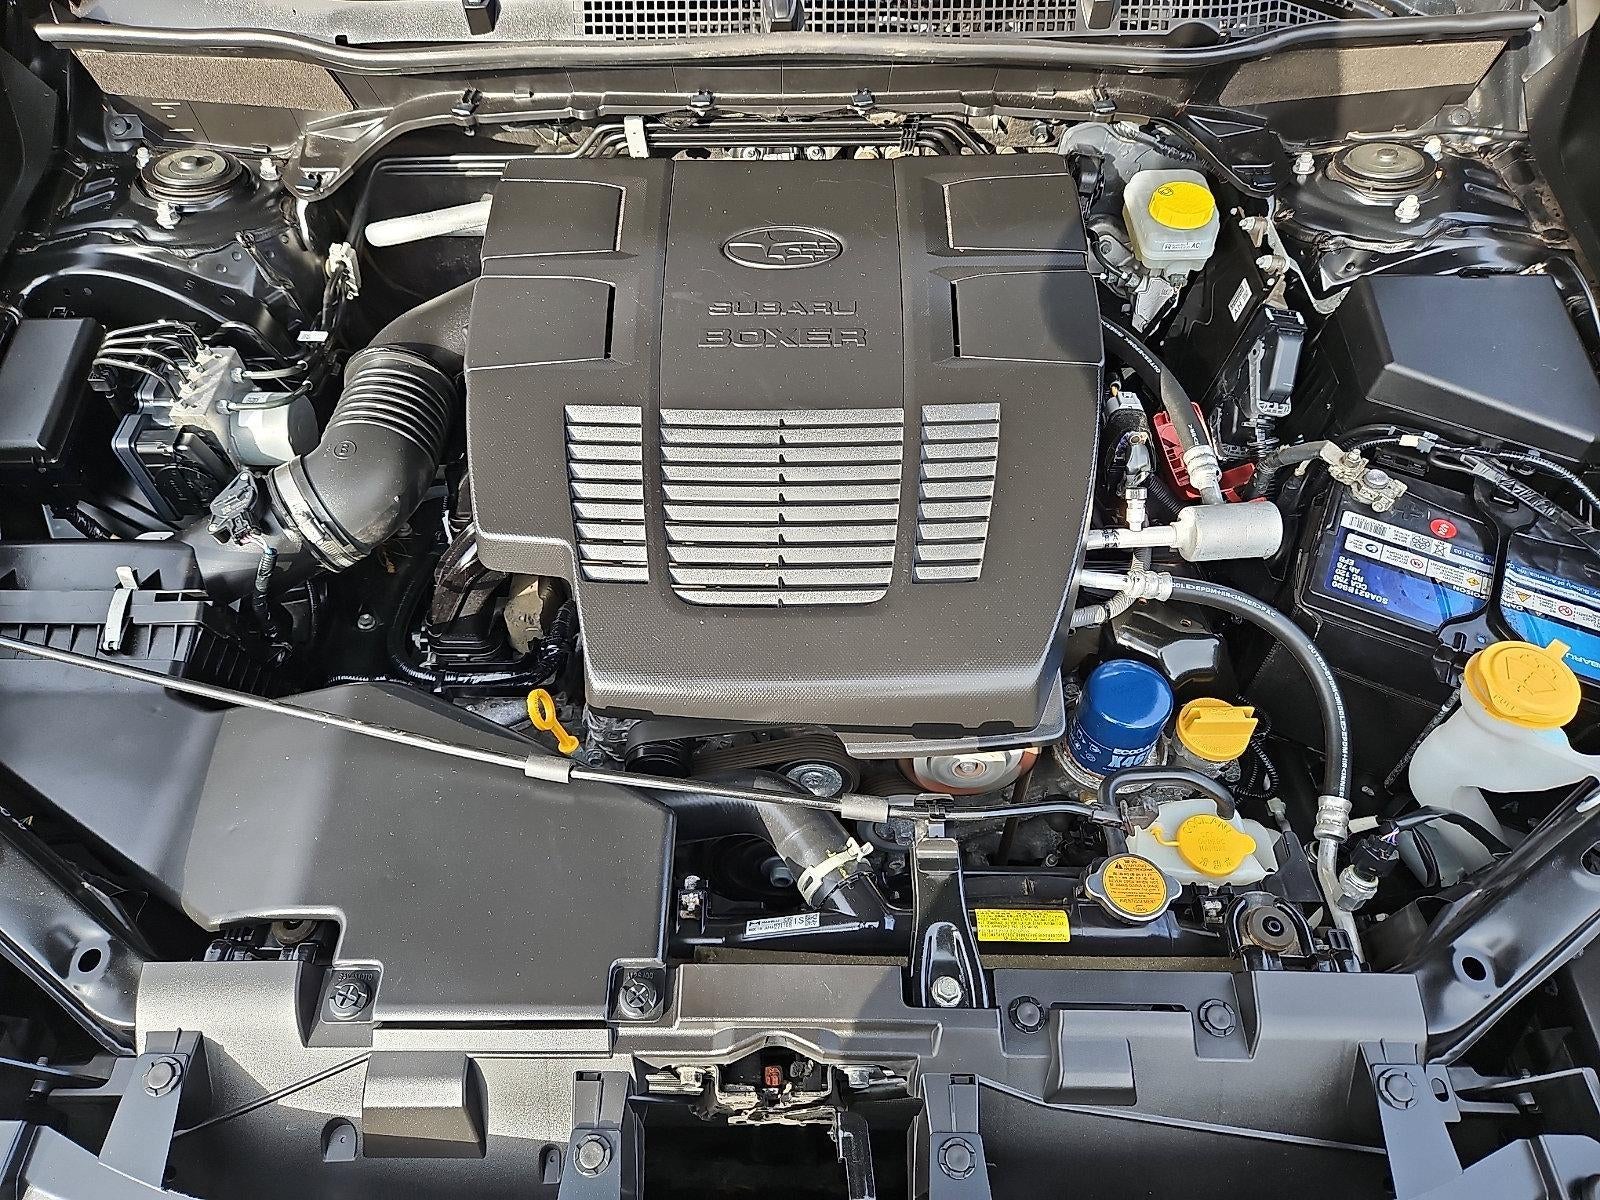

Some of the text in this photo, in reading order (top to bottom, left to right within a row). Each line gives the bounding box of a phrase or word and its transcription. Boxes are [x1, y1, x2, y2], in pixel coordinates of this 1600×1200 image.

[708, 300, 858, 317] SUBARU
[697, 328, 867, 348] BOXER
[1107, 752, 1149, 769] X46
